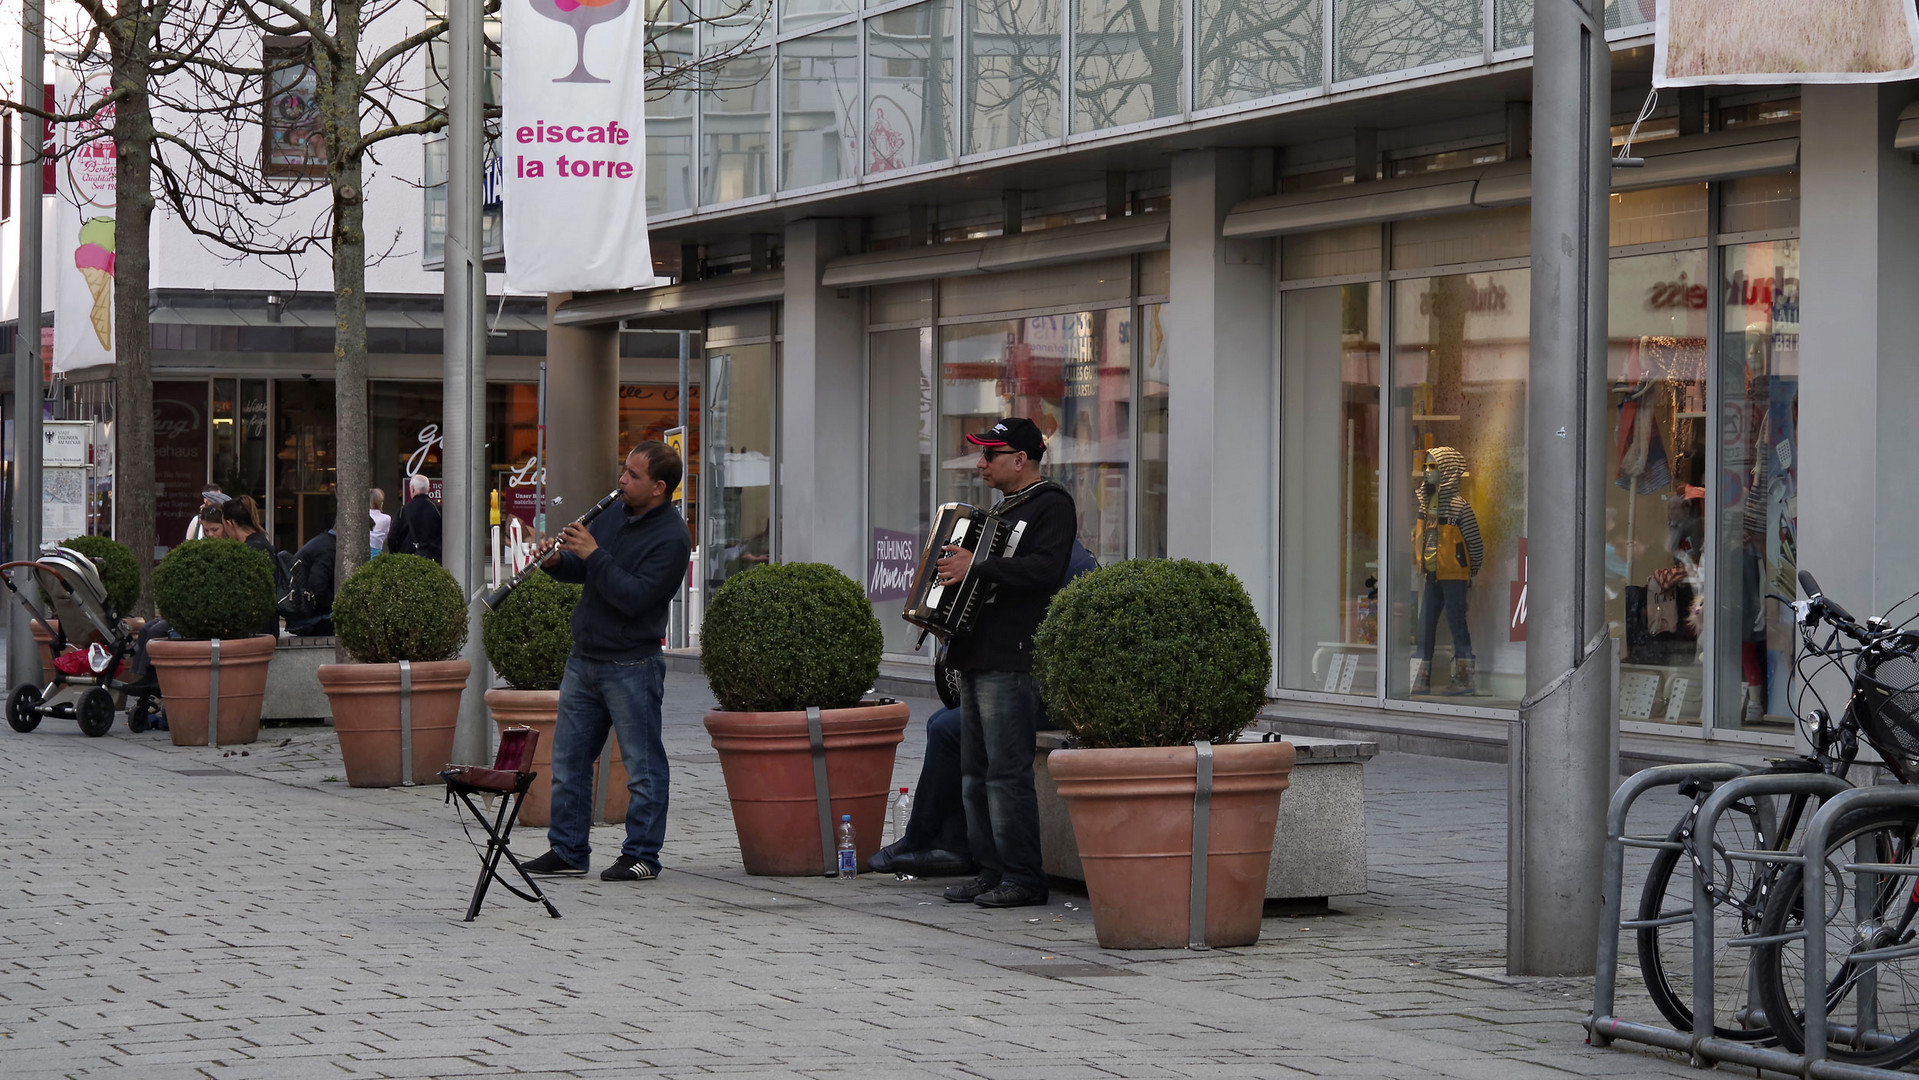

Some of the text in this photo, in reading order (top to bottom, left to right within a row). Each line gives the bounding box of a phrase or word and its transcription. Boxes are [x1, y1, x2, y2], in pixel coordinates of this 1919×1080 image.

[516, 120, 629, 145] eiscafe
[516, 154, 633, 179] la torre
[1064, 366, 1083, 382] ALLES
[877, 536, 912, 560] FRÜHLINGS
